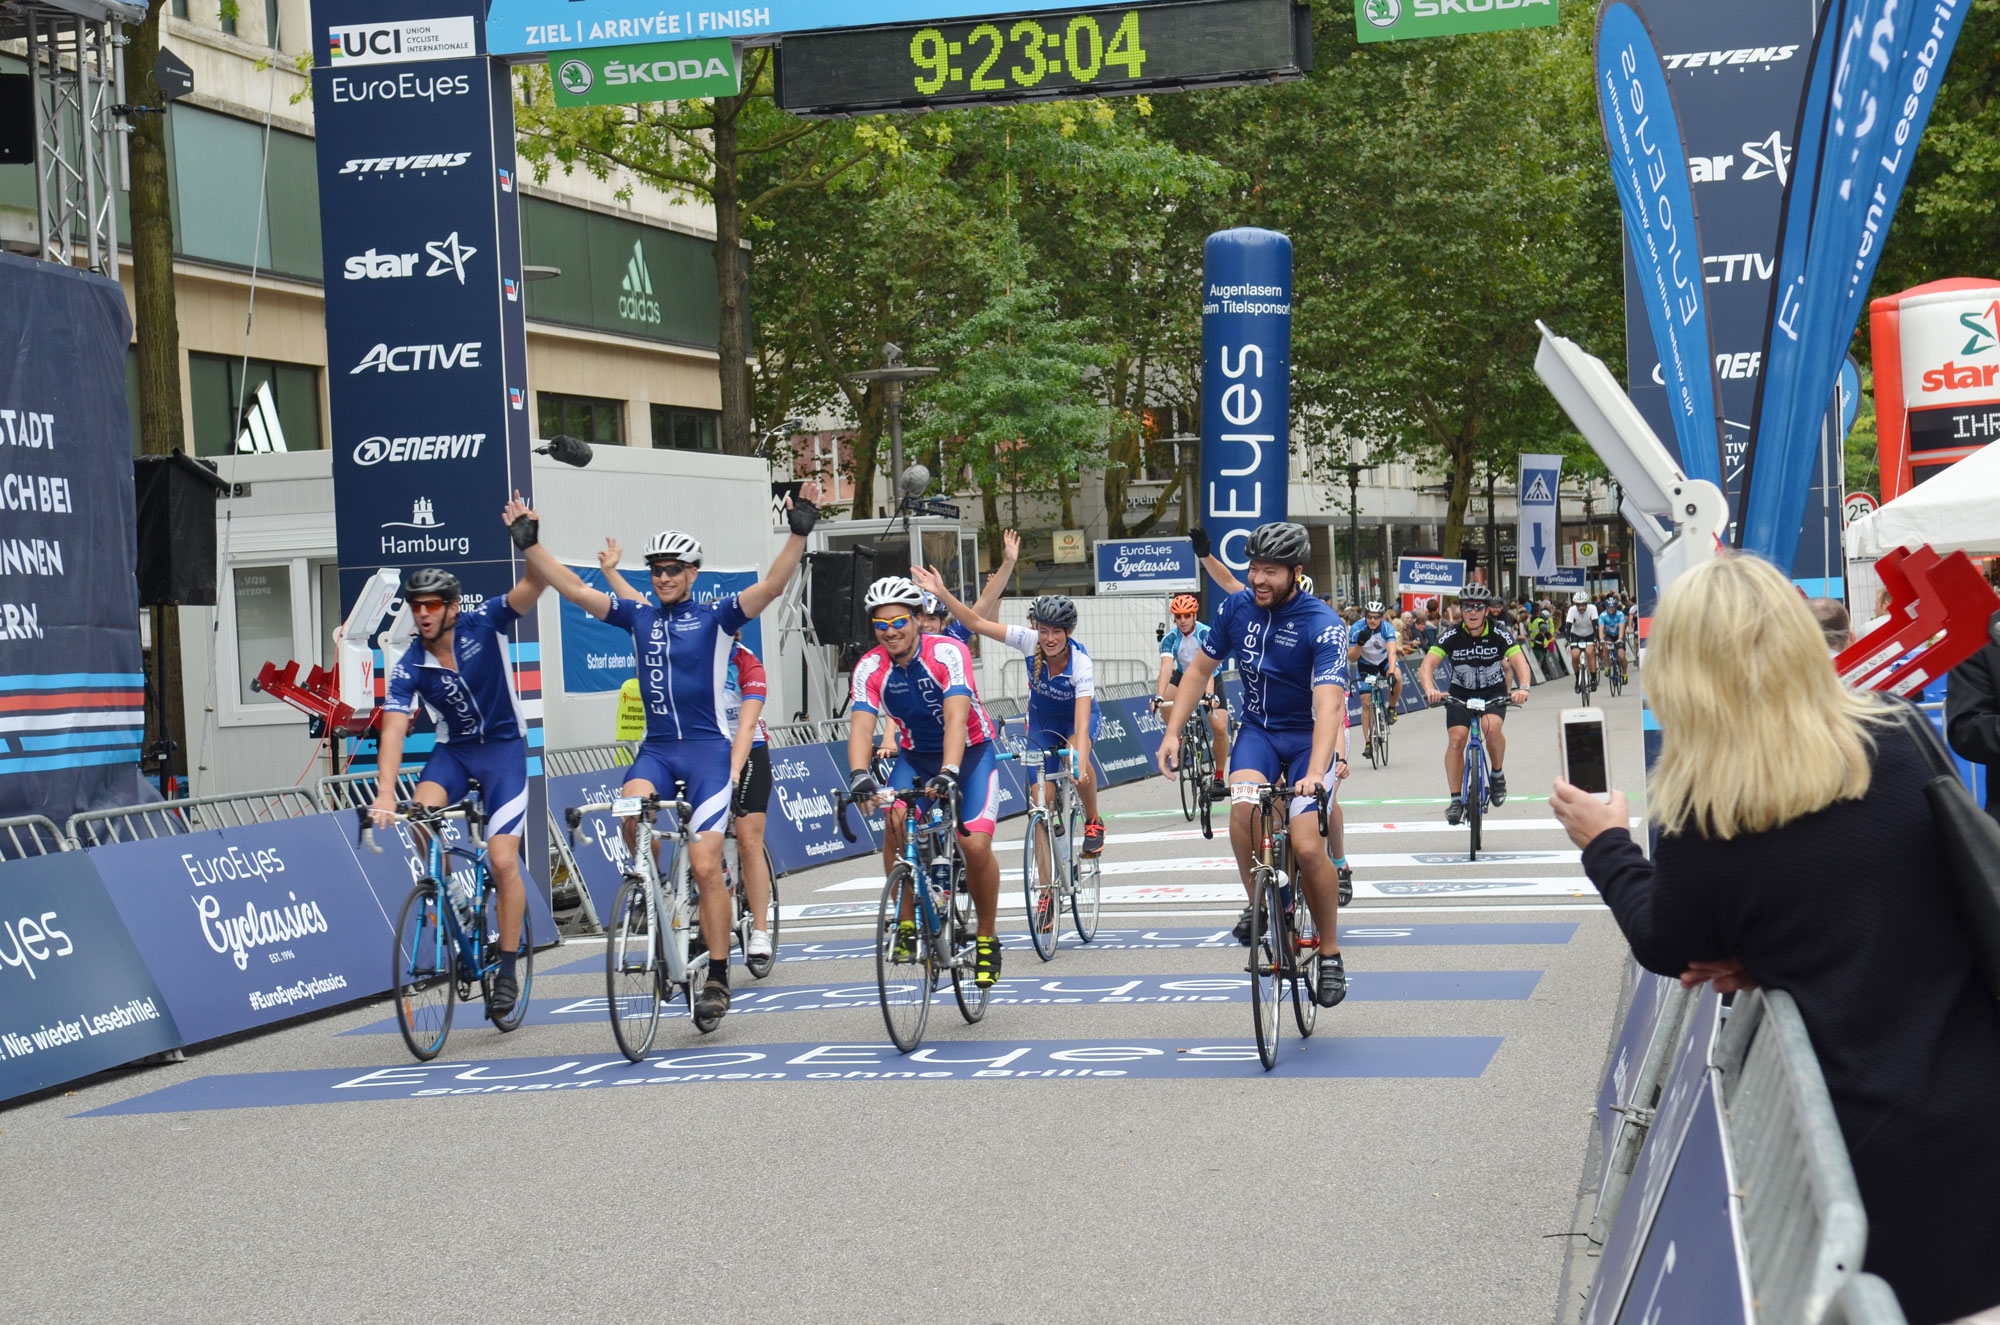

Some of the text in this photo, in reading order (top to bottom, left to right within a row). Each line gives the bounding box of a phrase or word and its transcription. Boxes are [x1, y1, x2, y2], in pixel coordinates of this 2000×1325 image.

[406, 27, 431, 35] UNION
[406, 35, 439, 44] CYCLISTE
[525, 8, 770, 45] ZIEL ARRIVÉE FINISH
[343, 29, 402, 57] UCI
[407, 42, 469, 53] INTERNATIONALE
[910, 10, 1146, 95] 9:23:04
[603, 57, 729, 85] ŠKODA
[1690, 64, 1771, 77] IKES
[332, 73, 469, 102] EuroEyes
[338, 152, 472, 174] STEVENS
[1688, 154, 1734, 183] ar
[344, 248, 419, 280] star
[1703, 253, 1775, 284] CTIV
[1209, 283, 1282, 299] Augenlasern
[619, 290, 661, 325] adidas
[349, 342, 482, 375] ACTIVE
[1921, 360, 2000, 392] star
[0, 409, 54, 449] TADT
[389, 433, 486, 462] ENERVIT
[1209, 343, 1275, 571] oEyes
[38, 476, 72, 514] BEI
[1848, 503, 1870, 522] 25
[381, 534, 469, 554] Hamburg
[1120, 545, 1172, 557] EuroEyes
[1113, 556, 1181, 577] Cyclassics
[1409, 568, 1453, 583] Cyclassics
[1414, 562, 1448, 571] EuroEyes
[458, 594, 483, 604] ORLD
[1106, 582, 1117, 591] 25
[587, 653, 607, 669] Scharf
[608, 653, 626, 669] sehen
[1452, 645, 1498, 657] SCHÜCO
[181, 846, 285, 887] EuroEyes
[190, 890, 329, 971] Cyclassics
[0, 911, 73, 980] yes
[269, 950, 295, 964] EST. 1996
[249, 972, 347, 1011] #EuroEyesCyclassics
[2, 996, 161, 1058] Nie wieder Lesebrille!
[805, 1070, 953, 1080] ohne
[970, 1067, 1129, 1079] Brille
